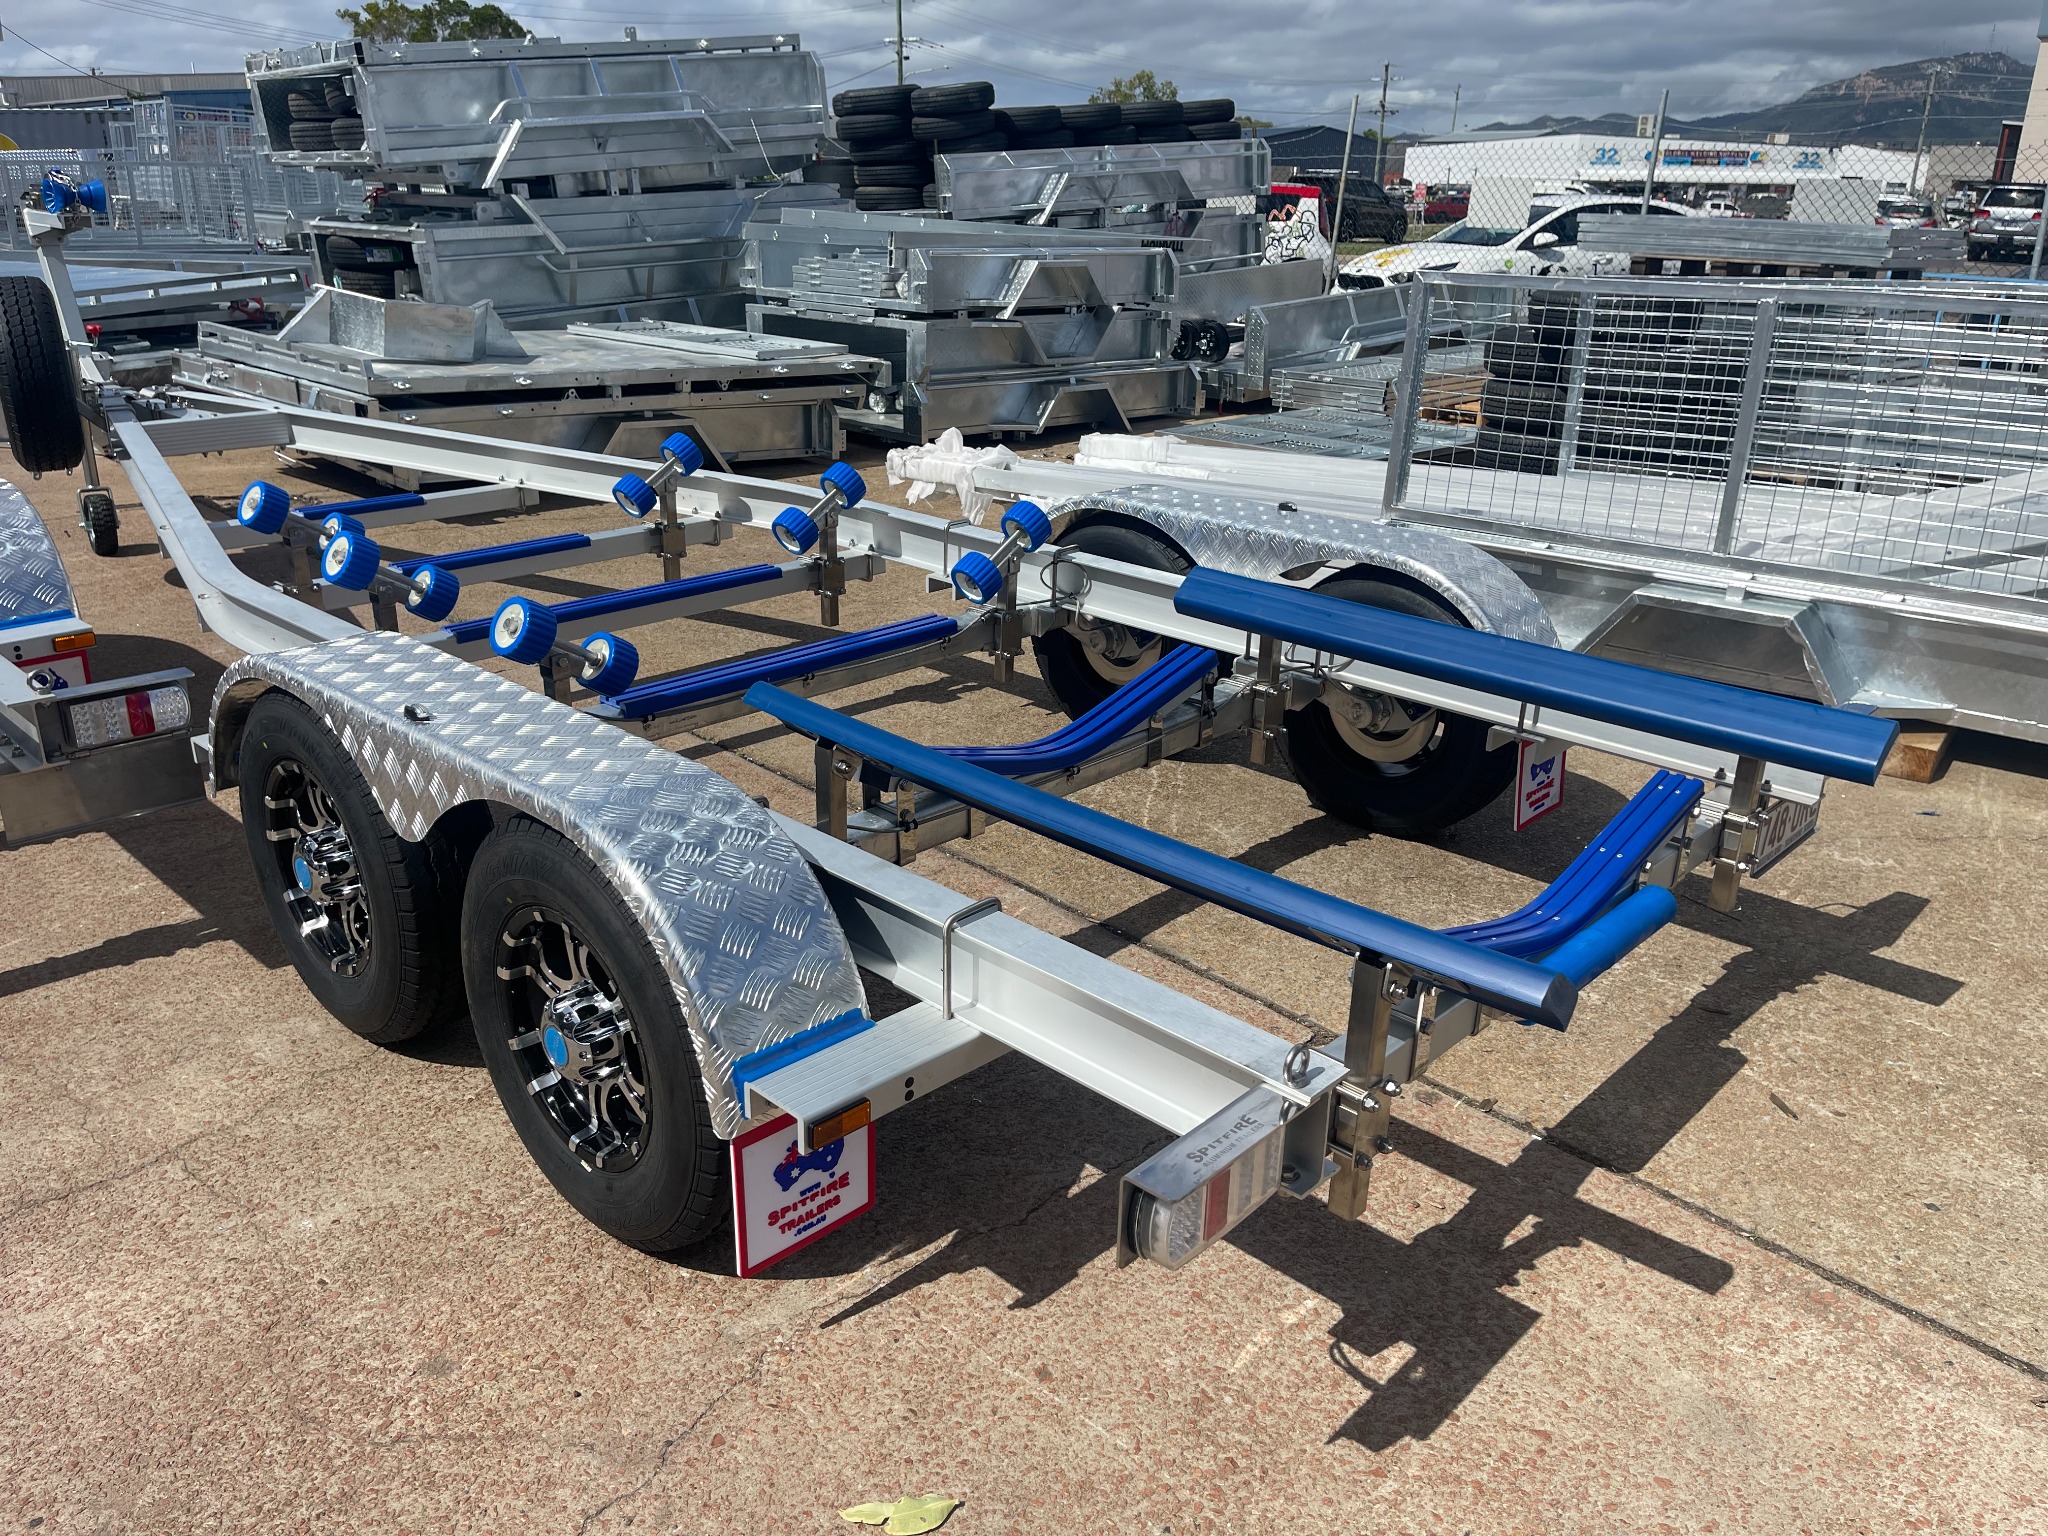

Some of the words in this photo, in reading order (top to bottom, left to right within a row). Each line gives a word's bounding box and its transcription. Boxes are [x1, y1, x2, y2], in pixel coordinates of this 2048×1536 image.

[1595, 148, 1618, 161] 32
[1799, 152, 1820, 165] 32
[1186, 1114, 1258, 1163] SPITFIRE
[1203, 1142, 1237, 1167] ALUMINIUM
[1236, 1122, 1265, 1142] TRAILERS
[768, 1171, 850, 1226] SPITFIRE
[779, 1195, 841, 1234] TRAILERS
